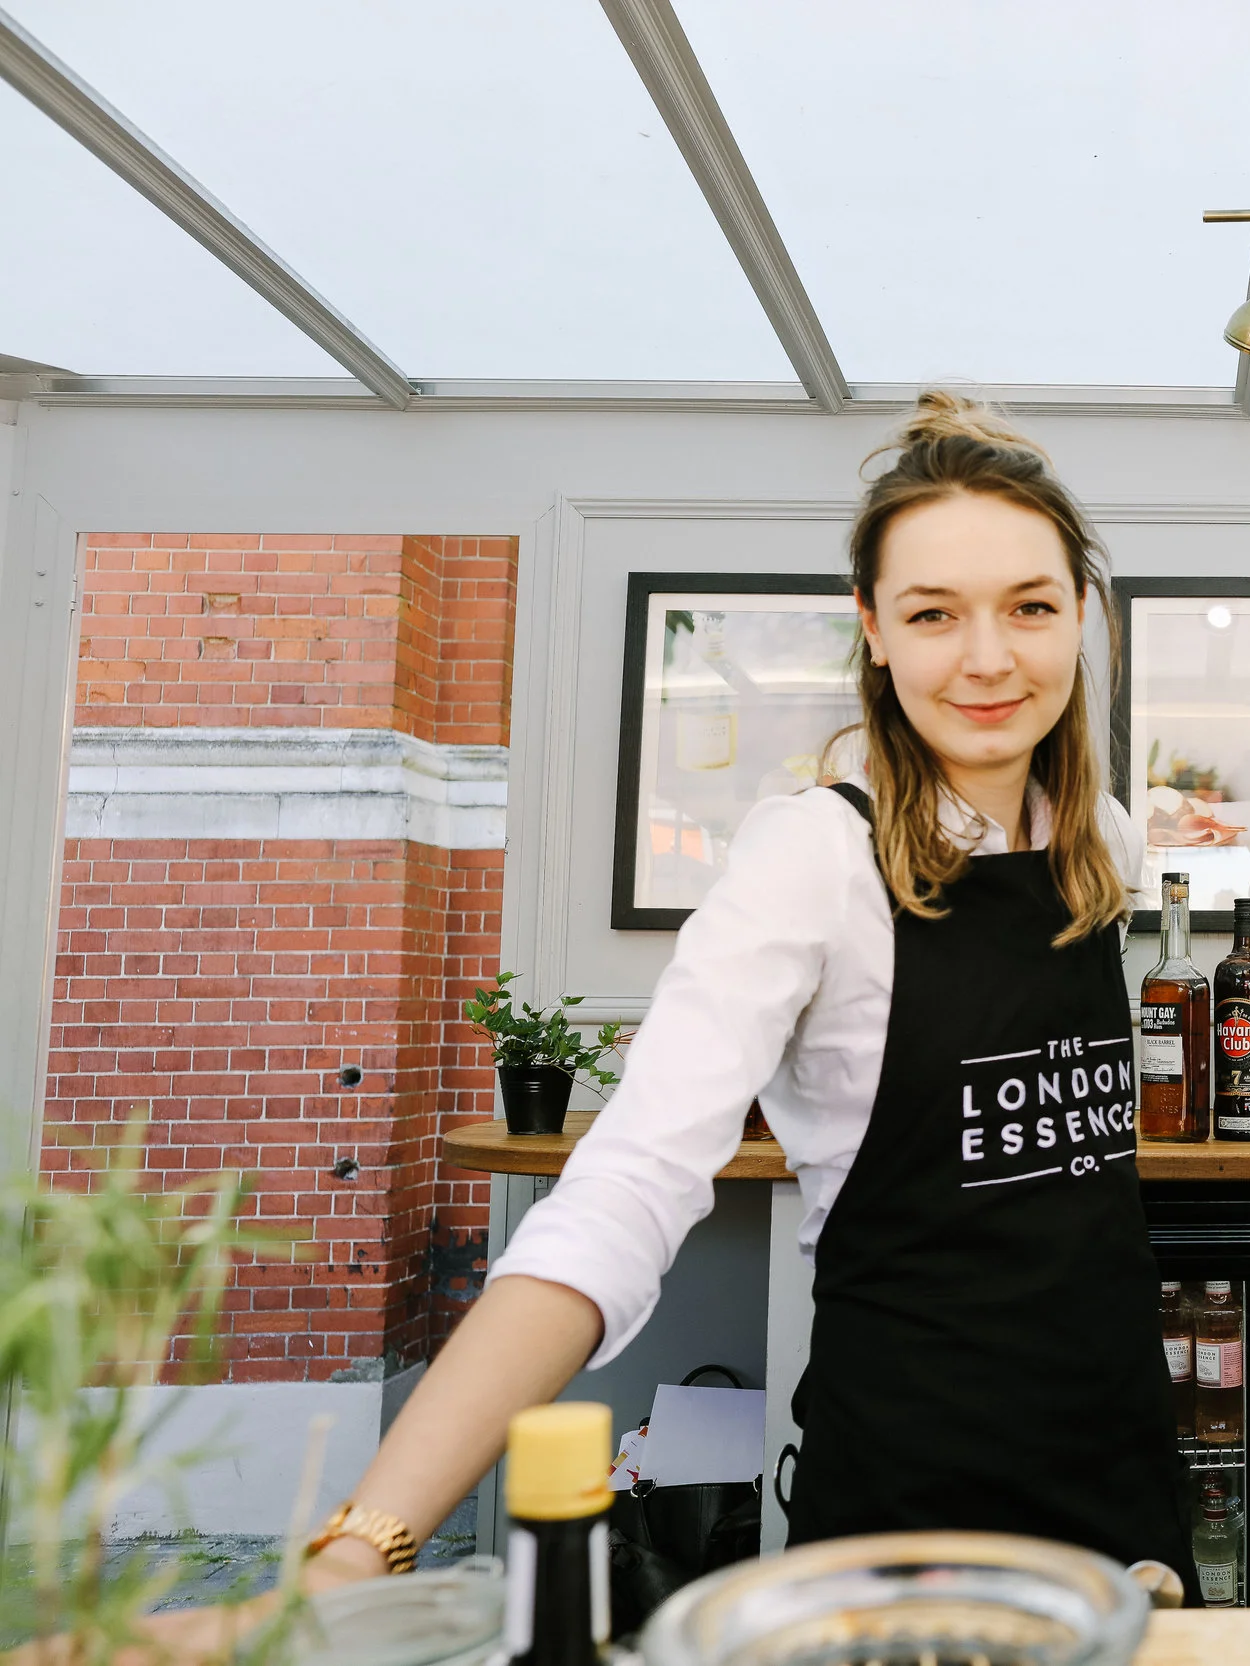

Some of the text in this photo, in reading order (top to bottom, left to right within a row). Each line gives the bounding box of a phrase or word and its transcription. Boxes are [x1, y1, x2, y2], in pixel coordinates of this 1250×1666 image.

[1159, 1007, 1175, 1018] GAY
[1047, 1037, 1083, 1059] THE
[1223, 1037, 1250, 1050] Club
[1231, 1070, 1242, 1085] 7
[962, 1059, 1131, 1118] LONDON
[962, 1101, 1134, 1161] ESSENCE
